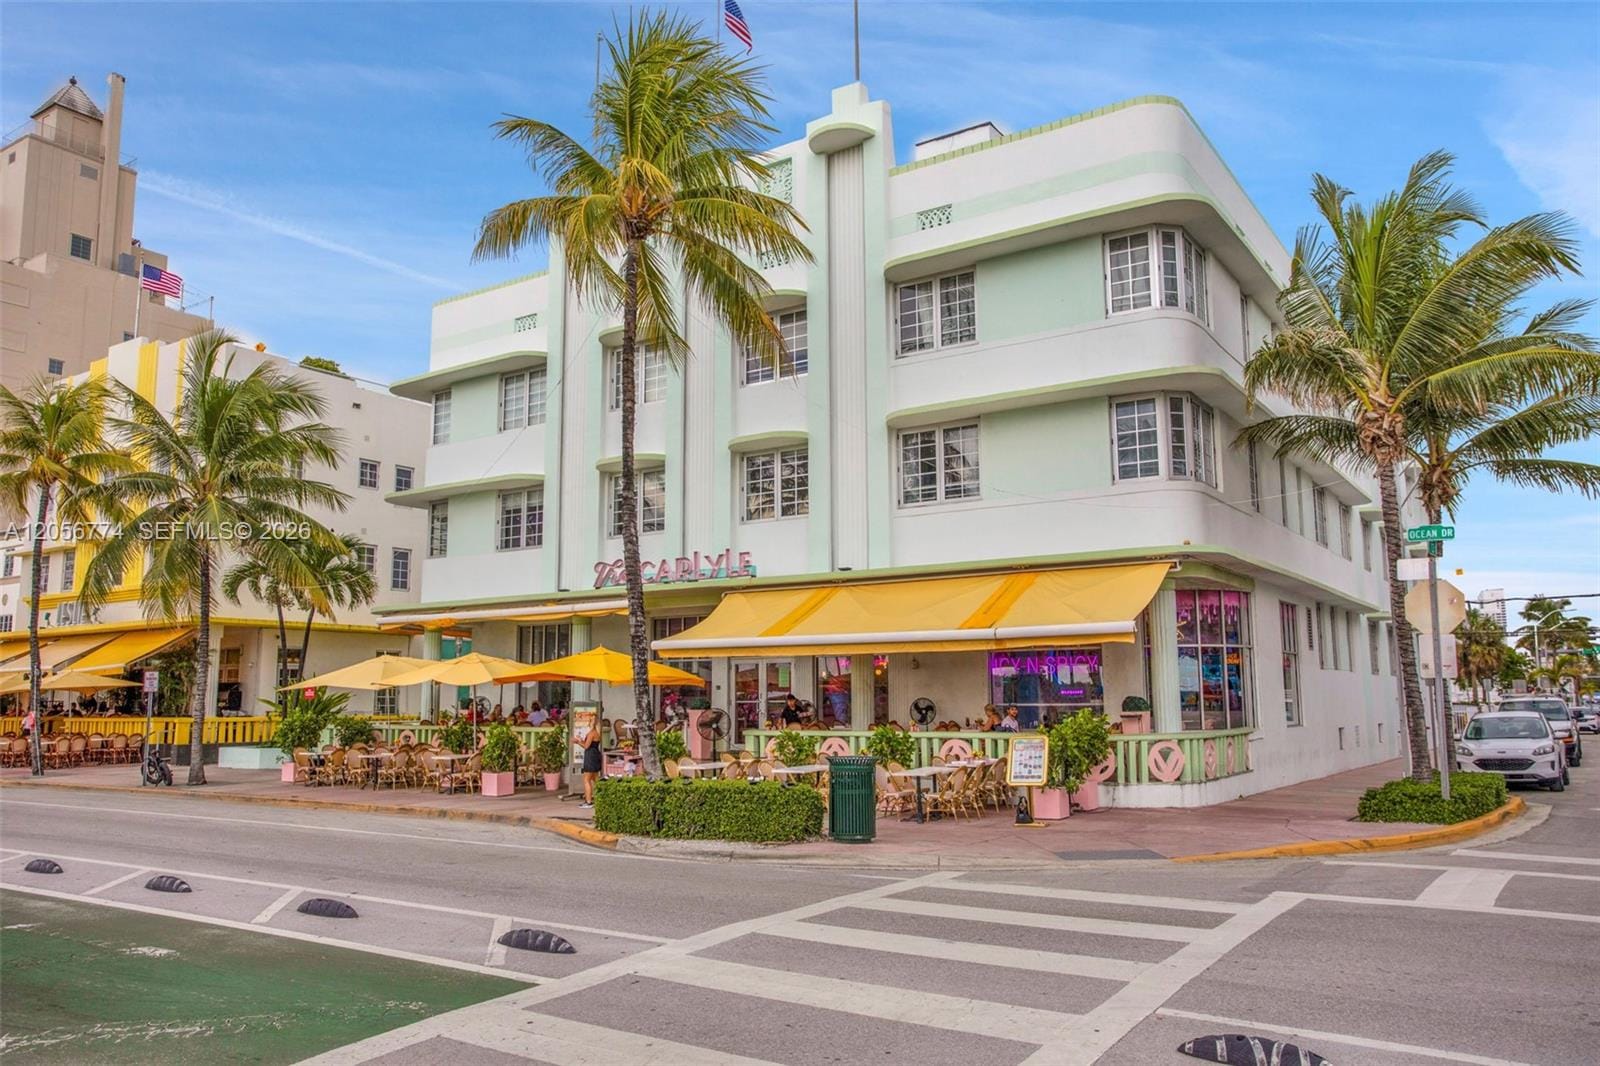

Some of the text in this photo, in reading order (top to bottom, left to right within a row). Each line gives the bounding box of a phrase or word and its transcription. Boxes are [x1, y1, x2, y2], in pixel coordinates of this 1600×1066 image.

[1409, 528, 1453, 539] OCEAN DR
[640, 548, 753, 584] CARLYLE
[994, 657, 1020, 673] ICY
[1045, 655, 1098, 674] SPICY
